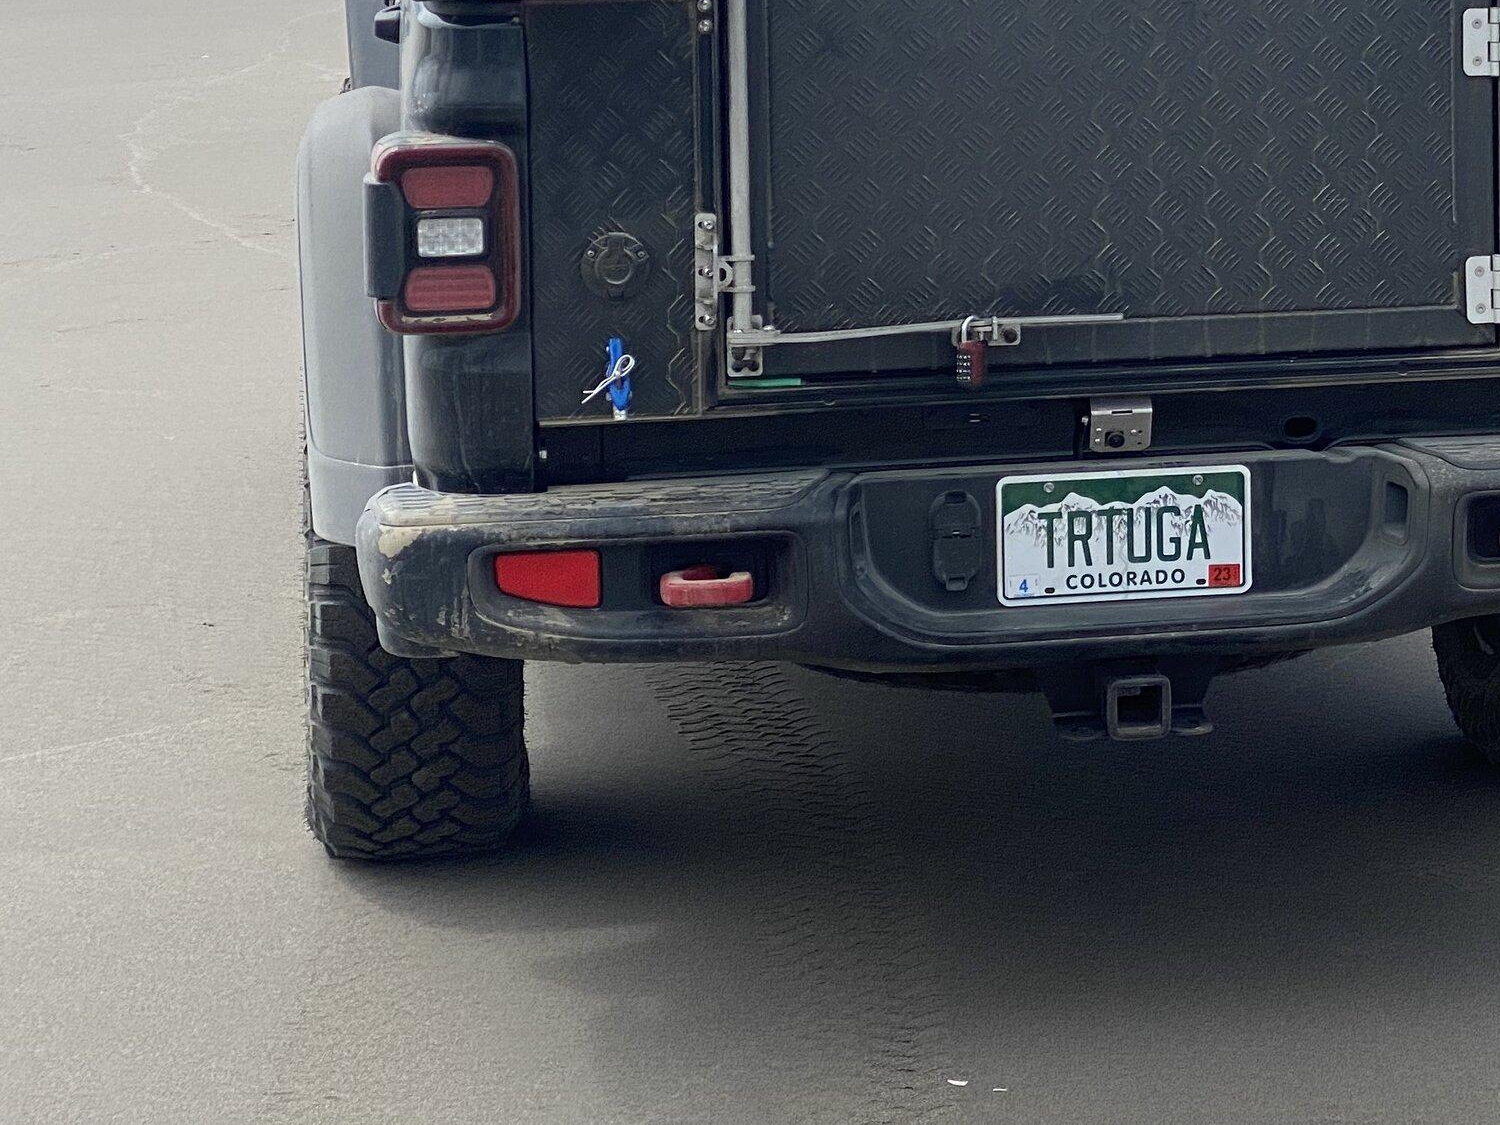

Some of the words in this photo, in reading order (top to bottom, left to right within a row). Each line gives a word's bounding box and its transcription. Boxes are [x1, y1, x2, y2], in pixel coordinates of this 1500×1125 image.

[1038, 505, 1211, 568] TRTUGA
[1066, 568, 1186, 590] COLORADO
[1213, 567, 1232, 581] 23
[1018, 579, 1029, 593] 4
